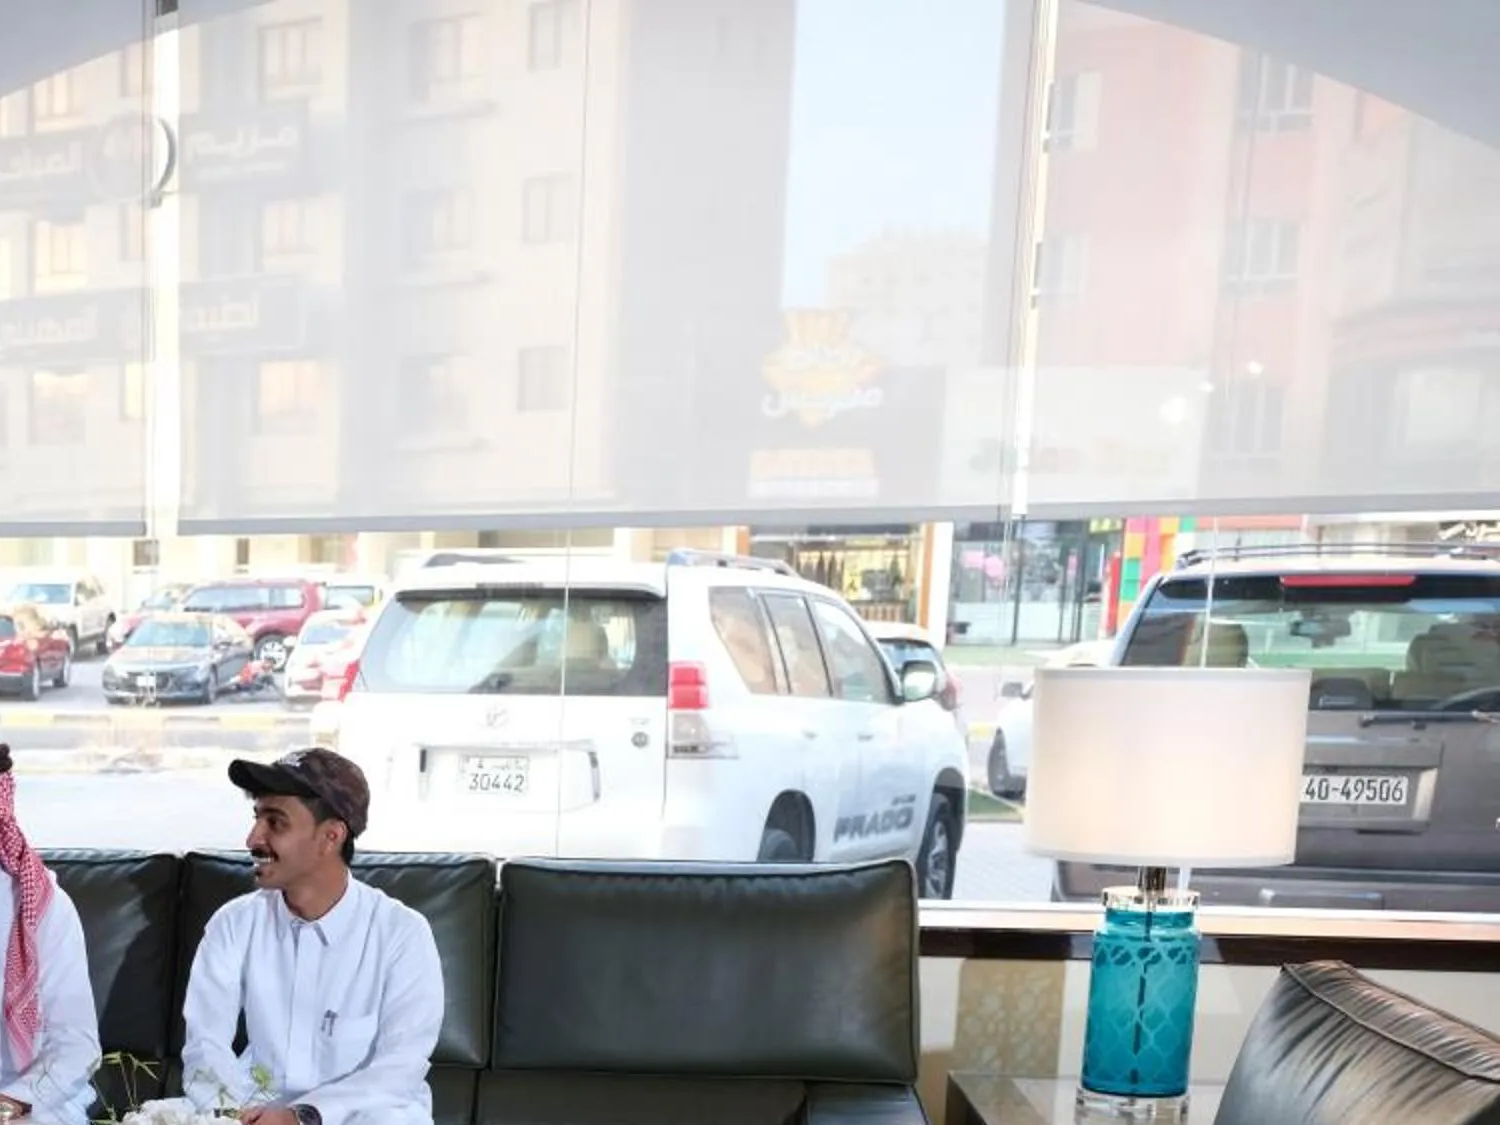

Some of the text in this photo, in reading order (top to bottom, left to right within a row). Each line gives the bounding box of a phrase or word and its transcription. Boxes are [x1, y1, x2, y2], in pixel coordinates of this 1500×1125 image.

[468, 773, 525, 793] 30442
[1304, 777, 1403, 802] 40-49506
[833, 806, 915, 843] PRADO
